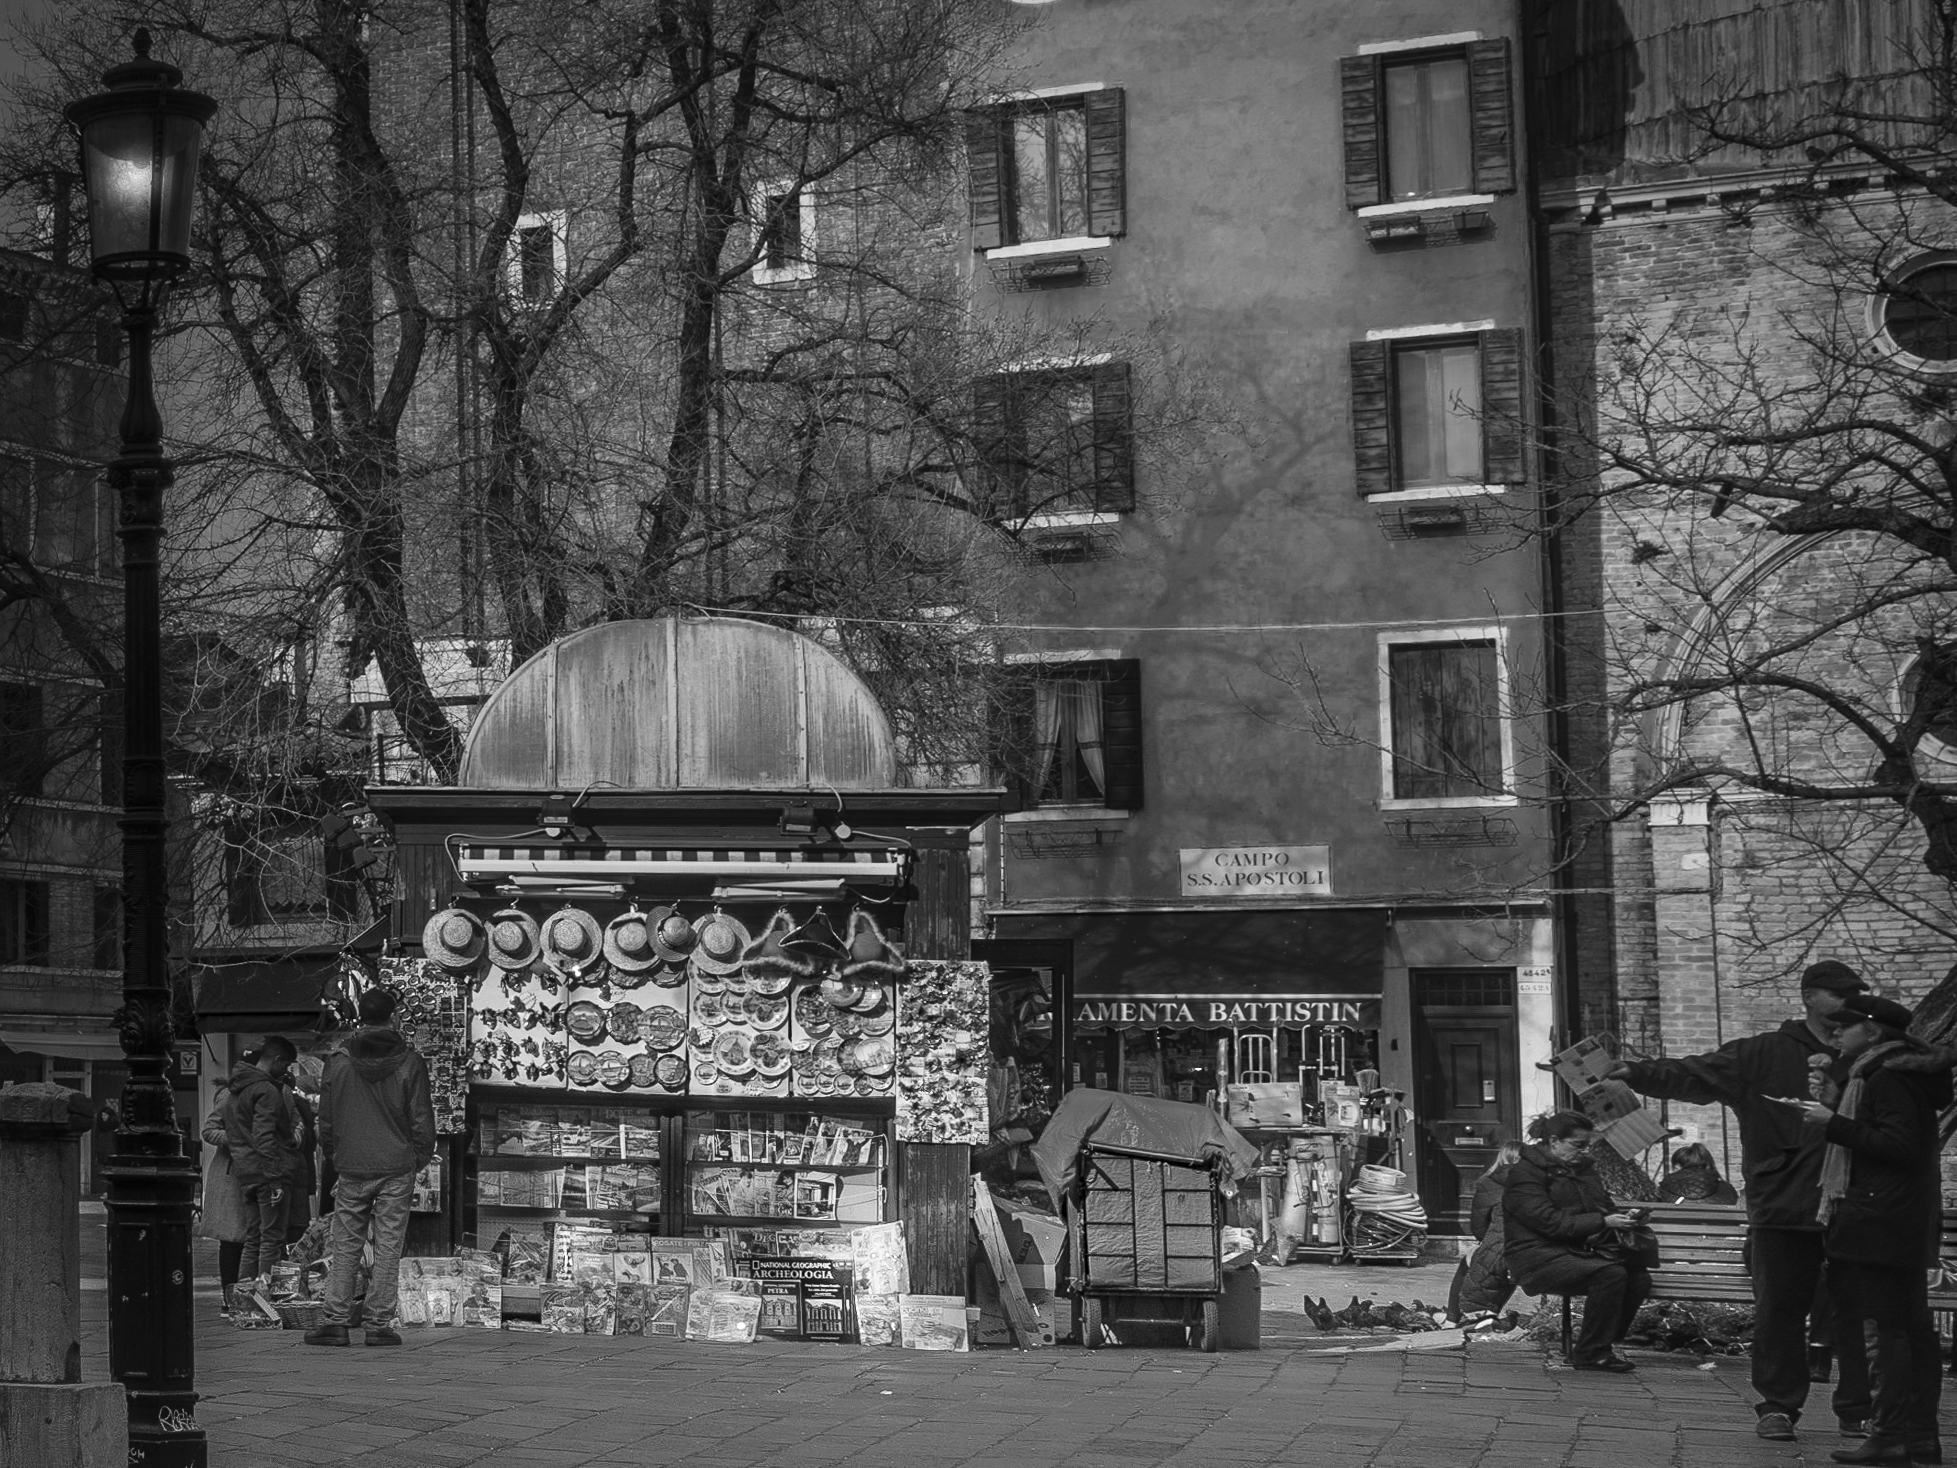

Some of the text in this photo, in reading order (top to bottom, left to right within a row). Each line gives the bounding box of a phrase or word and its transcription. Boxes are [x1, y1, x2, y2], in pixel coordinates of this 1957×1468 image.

[1214, 852, 1290, 867] CAMPO
[1073, 1002, 1362, 1023] AMENTA BATTISTIN
[752, 1269, 834, 1279] ARCHEOLOGIA
[767, 1287, 789, 1295] PETRA
